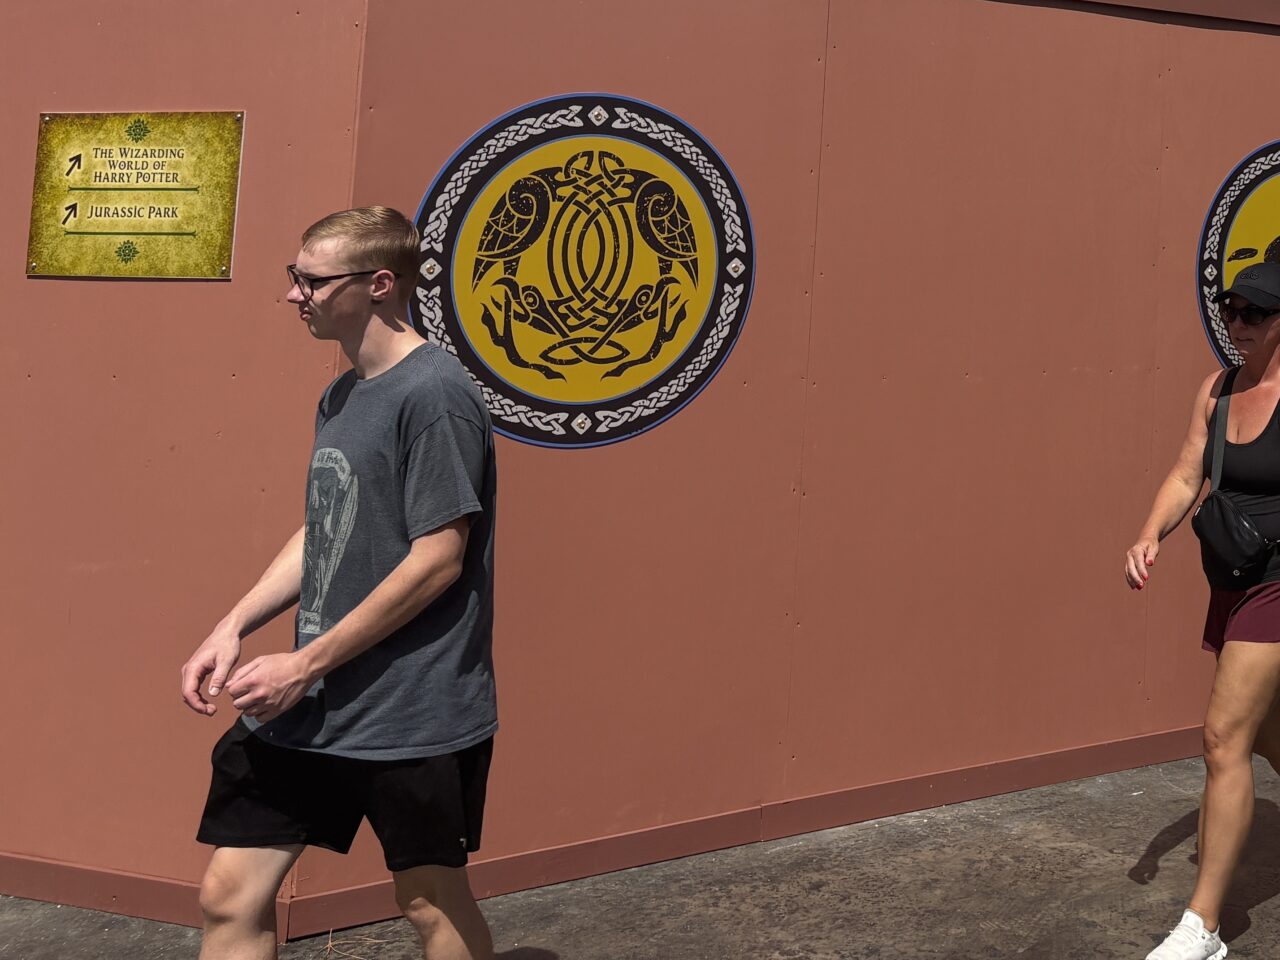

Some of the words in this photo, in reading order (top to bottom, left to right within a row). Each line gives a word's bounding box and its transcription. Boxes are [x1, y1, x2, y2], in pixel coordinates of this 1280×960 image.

[92, 147, 114, 158] THE
[119, 147, 185, 159] WIZARDING
[108, 159, 149, 170] WORLD
[93, 171, 132, 183] HARRY
[135, 171, 180, 184] POTTER
[148, 206, 178, 219] PARK
